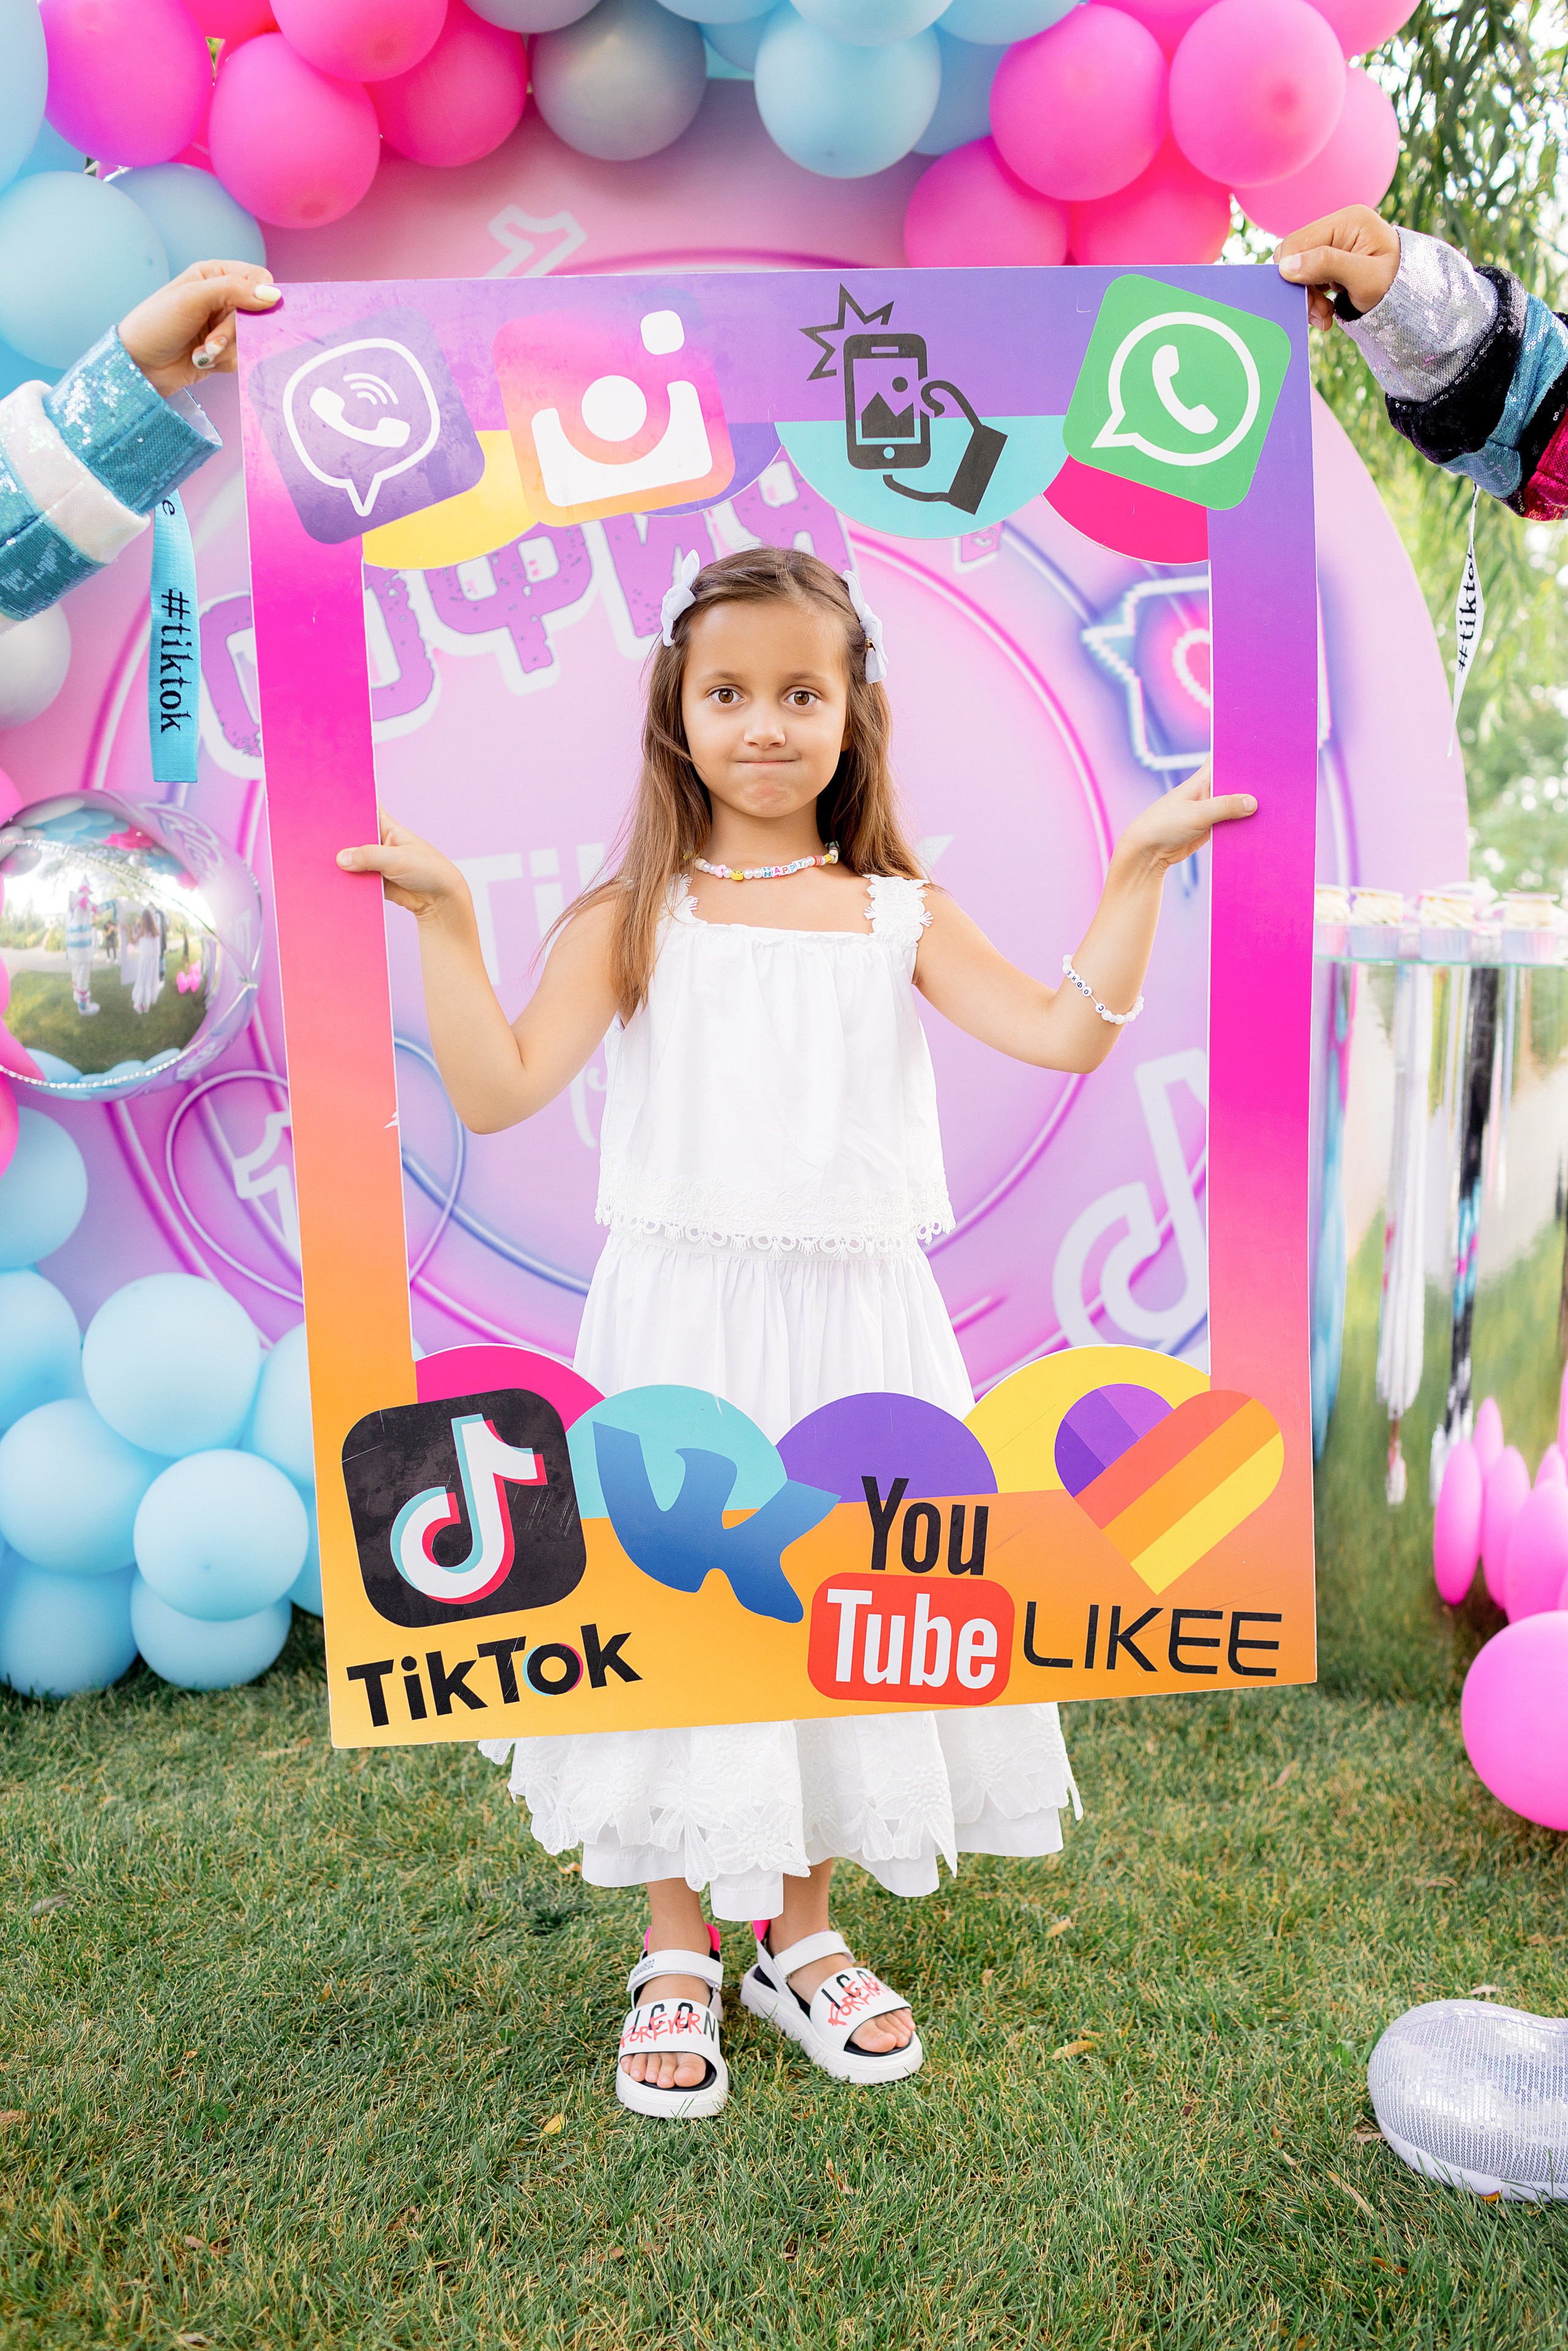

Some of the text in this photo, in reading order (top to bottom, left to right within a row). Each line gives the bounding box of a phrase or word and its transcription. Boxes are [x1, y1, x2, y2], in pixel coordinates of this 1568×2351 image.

[160, 587, 193, 734] #tiktok
[1458, 551, 1477, 673] #tikto
[763, 861, 804, 878] HAPPY
[861, 1476, 989, 1576] You
[346, 1623, 643, 1727] TikTok
[826, 1588, 998, 1689] Tube
[1023, 1601, 1283, 1677] LIKEE
[620, 2010, 702, 2048] FOREVER
